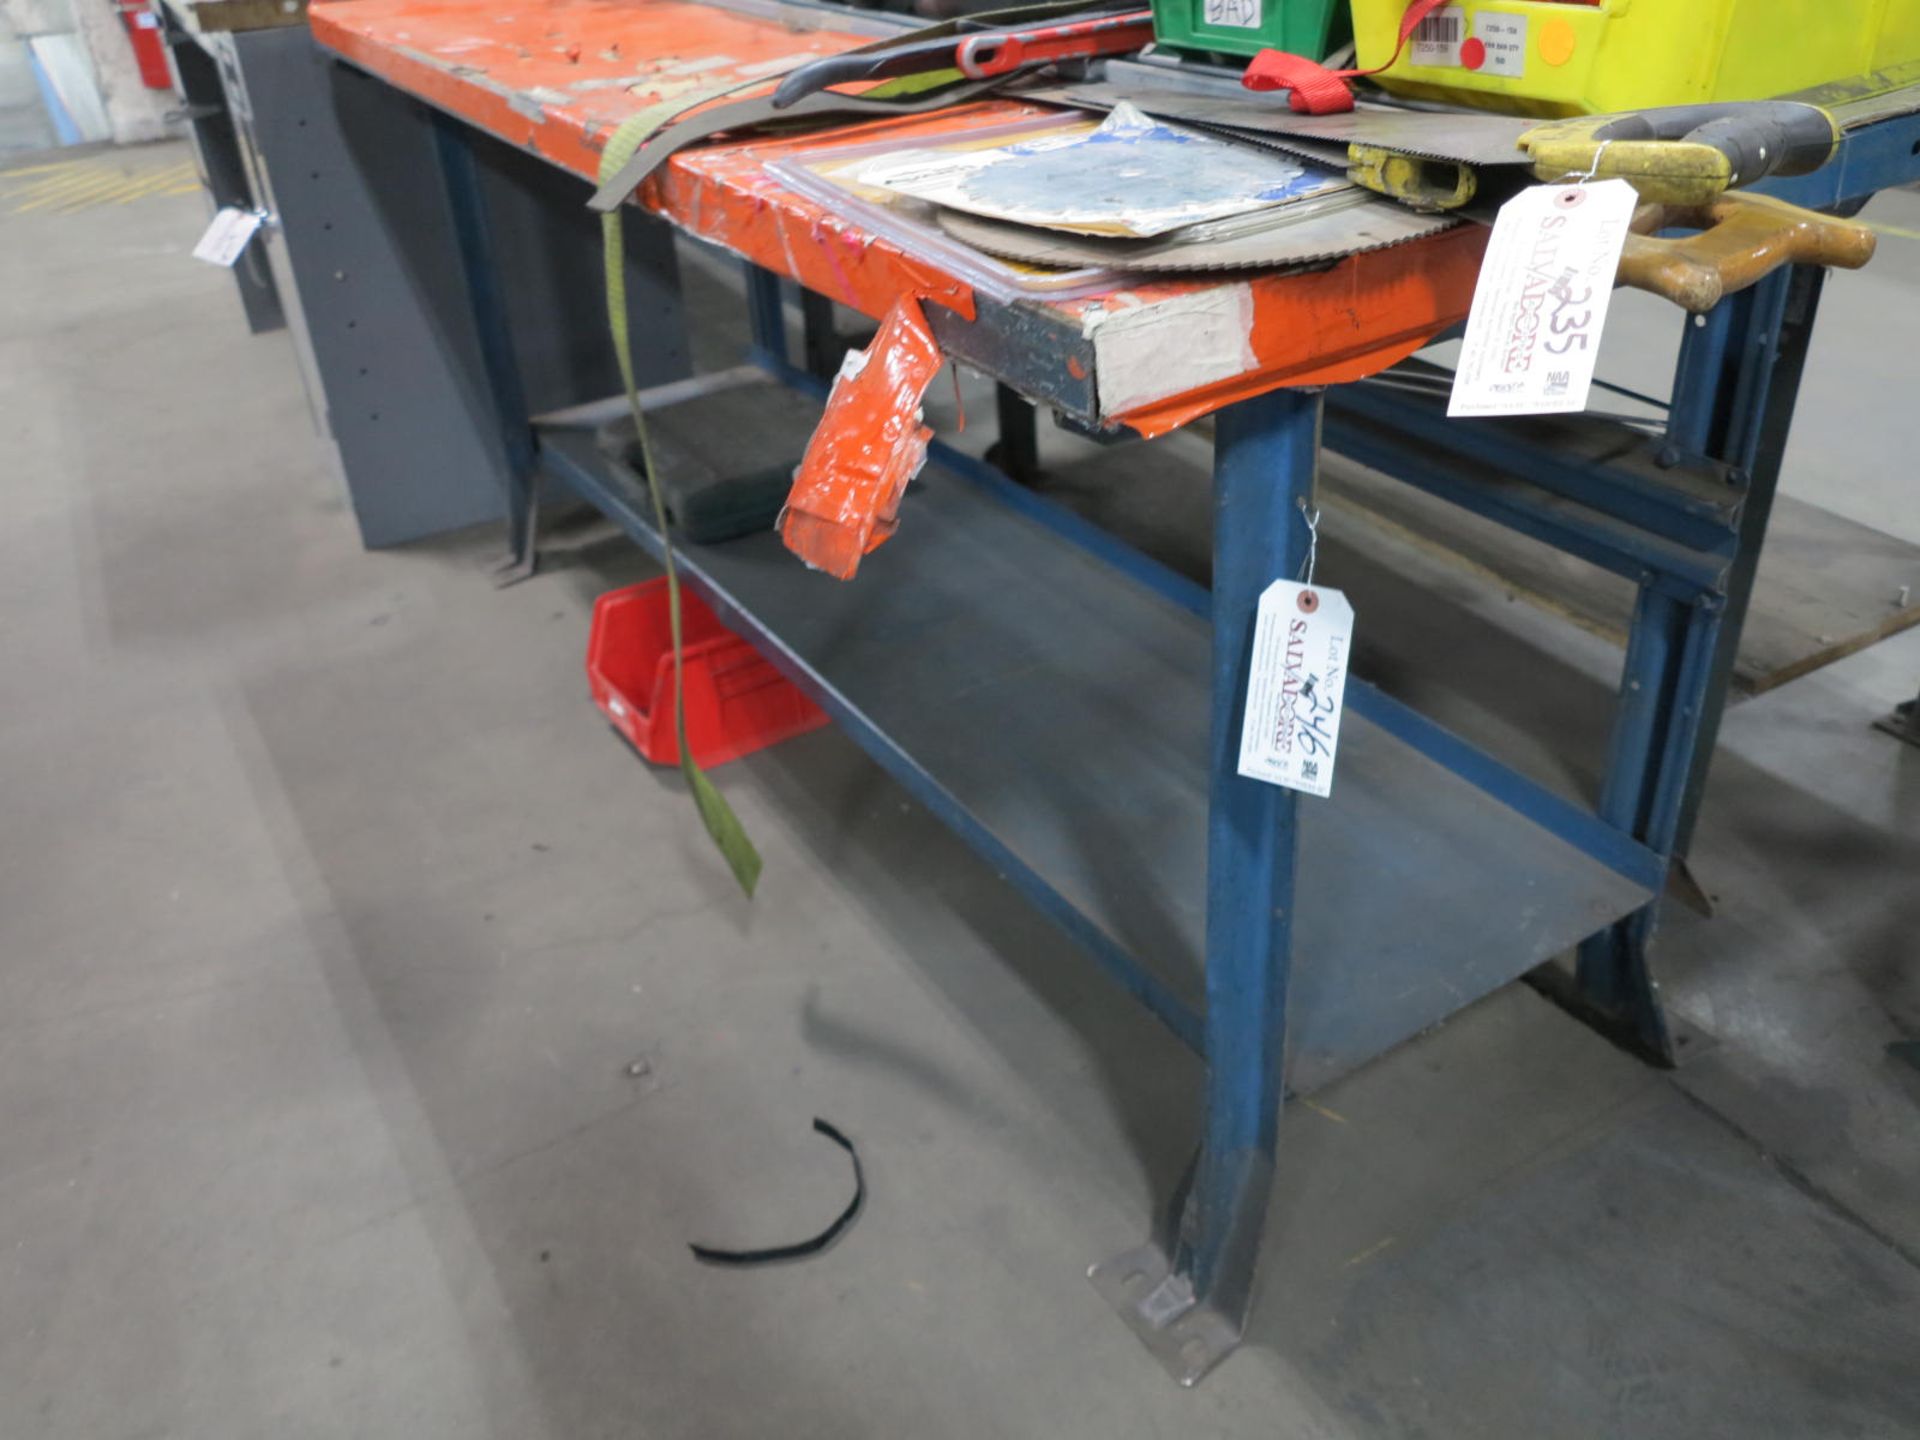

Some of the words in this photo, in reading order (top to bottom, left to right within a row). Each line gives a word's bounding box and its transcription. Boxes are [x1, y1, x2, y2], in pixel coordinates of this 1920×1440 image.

[1504, 215, 1567, 374] SALVADORE
[1543, 284, 1593, 355] 235
[1324, 665, 1340, 691] No.
[1328, 634, 1344, 661] Lot
[1274, 618, 1308, 754] SALVADORE
[1297, 694, 1335, 758] 246
